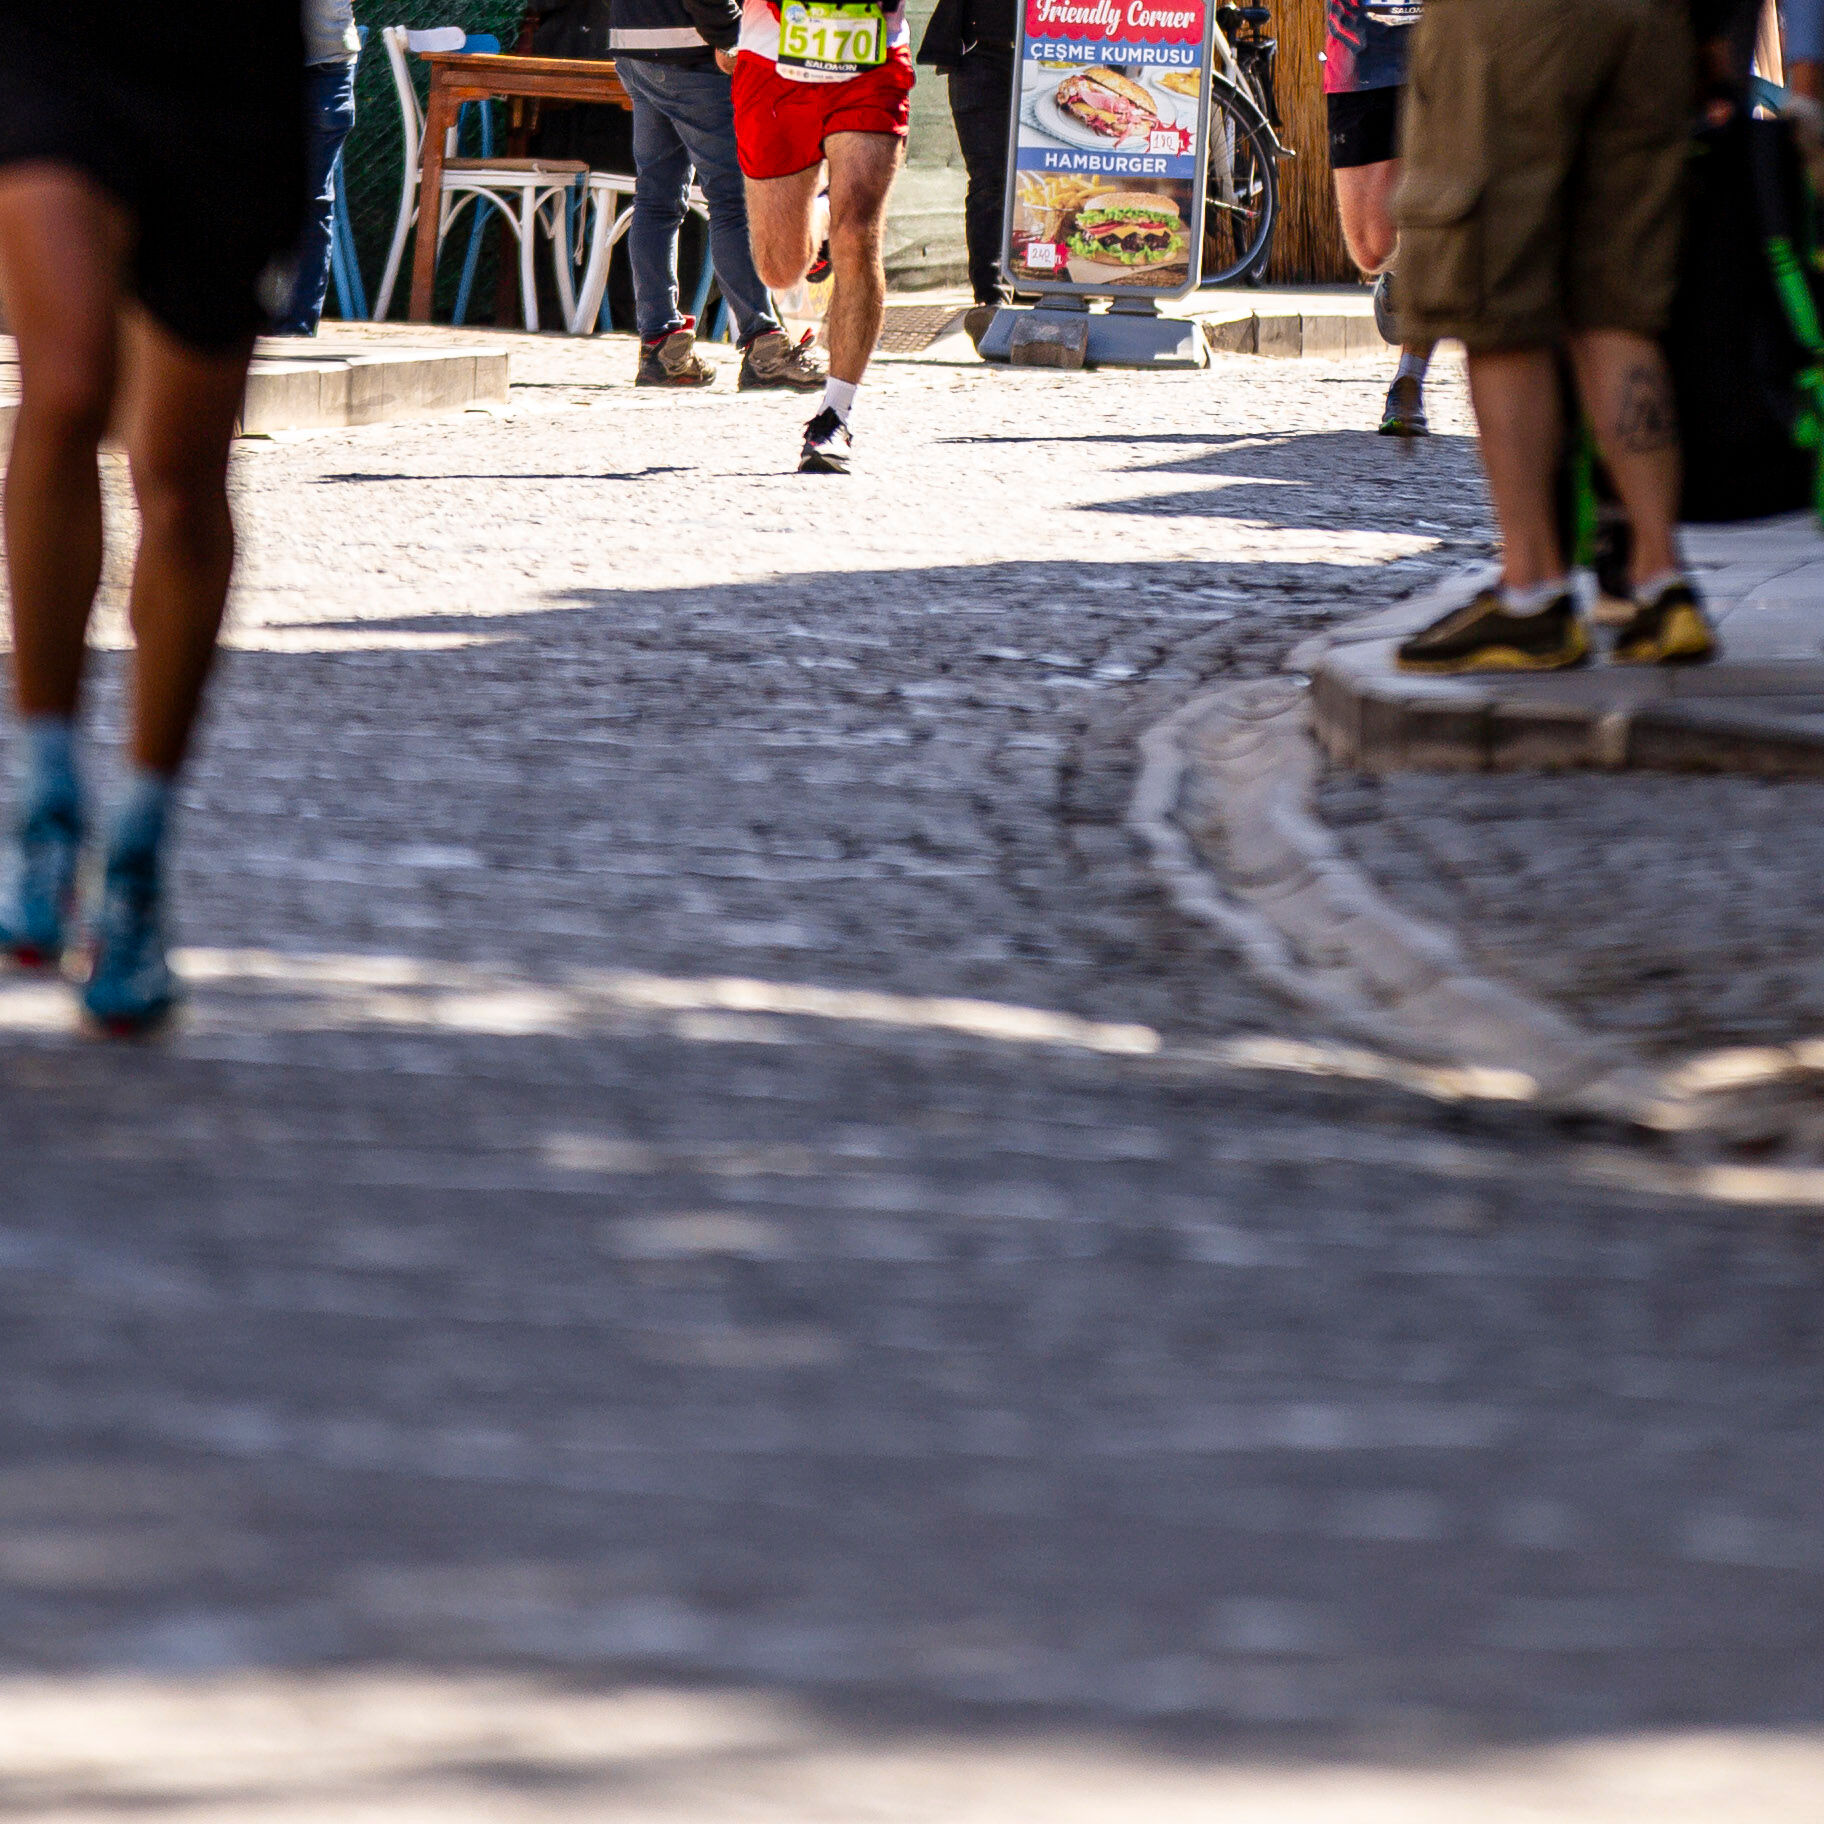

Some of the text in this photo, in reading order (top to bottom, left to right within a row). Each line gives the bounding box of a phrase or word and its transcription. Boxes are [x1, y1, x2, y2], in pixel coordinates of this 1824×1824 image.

[1126, 0, 1196, 30] Corner
[788, 25, 873, 61] 5170
[1030, 42, 1194, 65] ÇEŞME KUMRUSU
[1044, 152, 1168, 174] HAMBURGER
